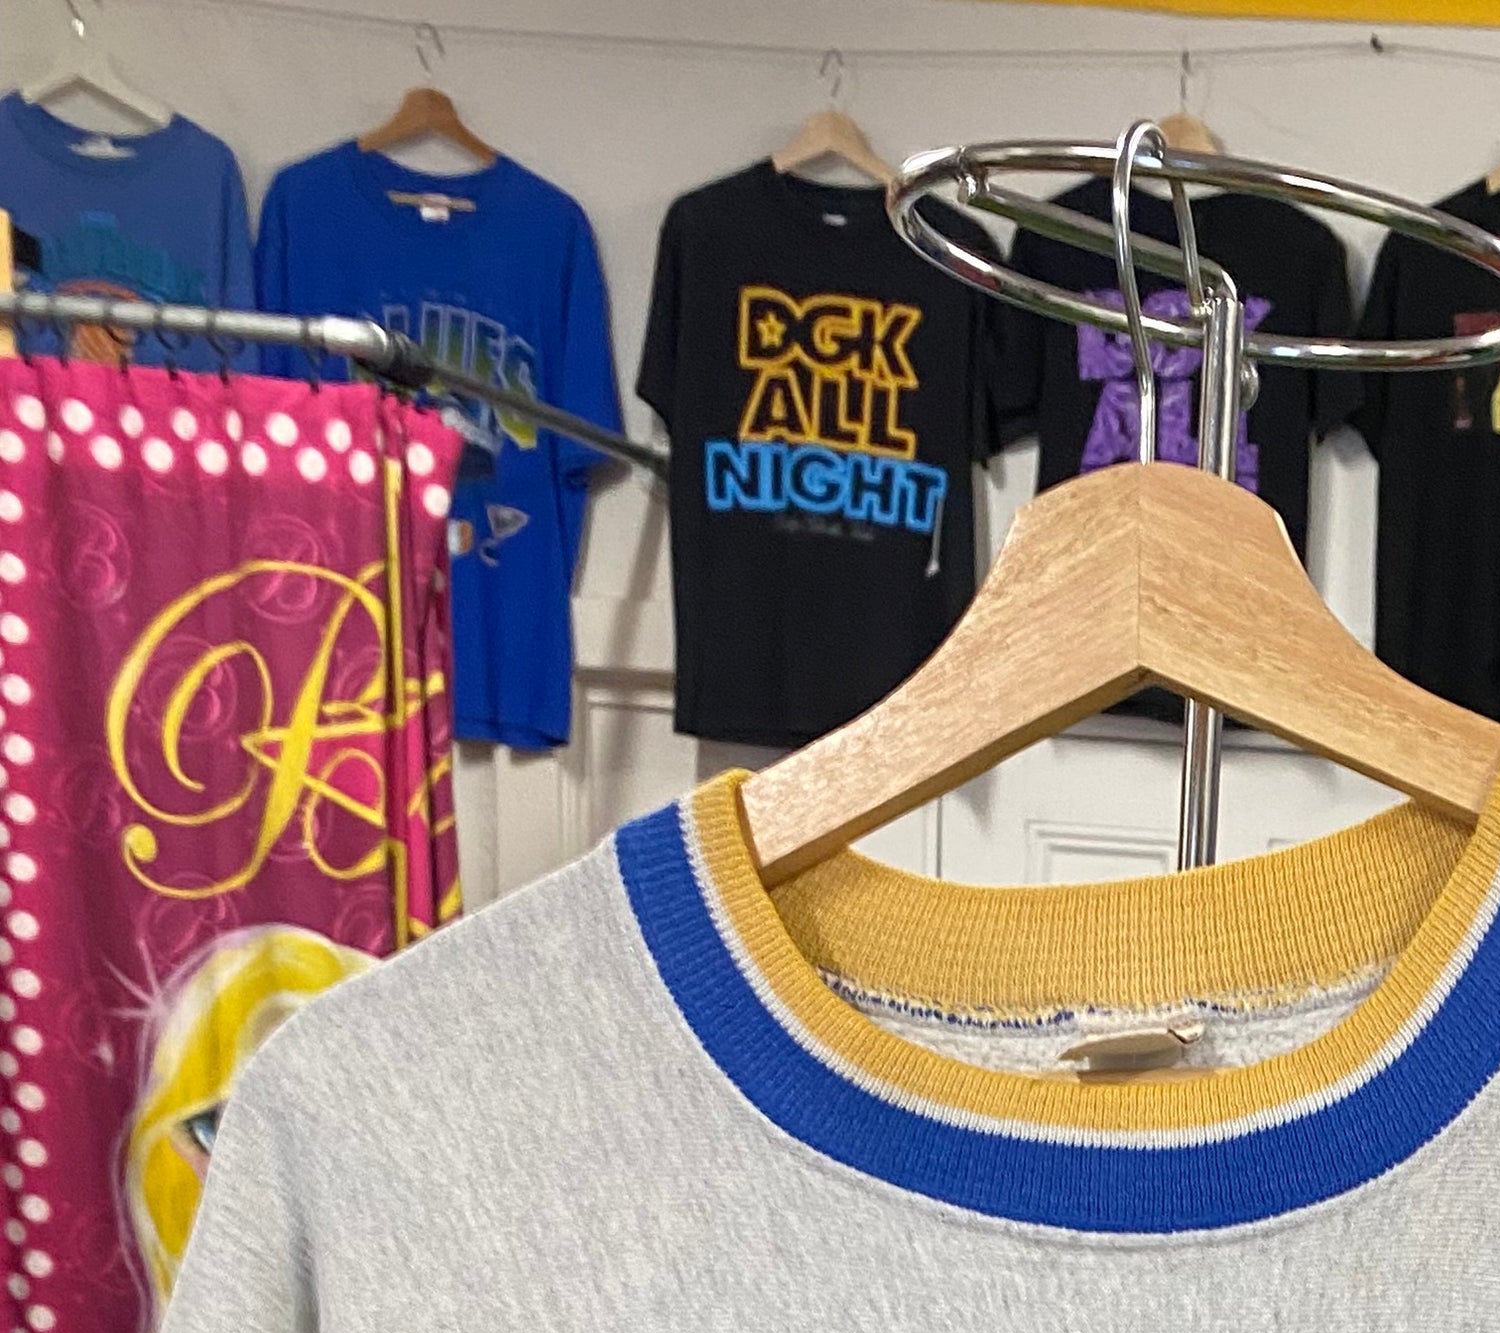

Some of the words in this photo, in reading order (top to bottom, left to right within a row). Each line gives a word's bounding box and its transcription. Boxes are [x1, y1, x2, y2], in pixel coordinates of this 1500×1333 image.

[739, 286, 922, 390] DGK
[739, 366, 916, 460] ALL
[704, 438, 948, 534] NIGHT
